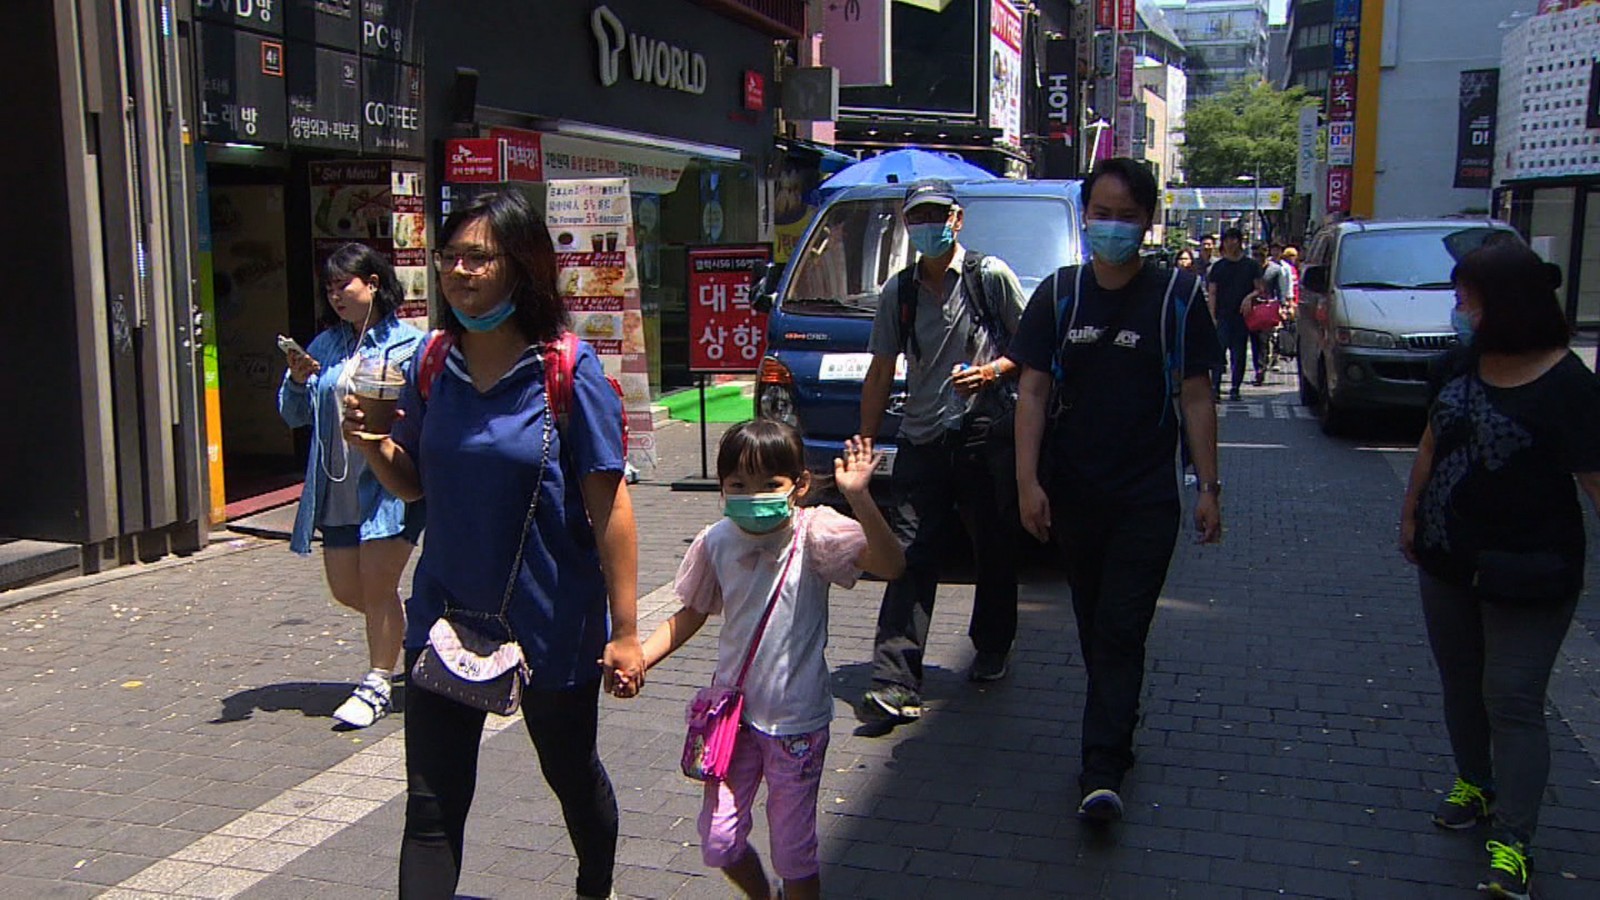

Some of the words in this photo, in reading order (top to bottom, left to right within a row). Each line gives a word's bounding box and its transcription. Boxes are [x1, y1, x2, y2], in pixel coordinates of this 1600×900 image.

[629, 33, 707, 95] WORLD
[364, 101, 418, 130] COFFEE
[1048, 74, 1069, 124] HOT
[200, 100, 258, 136] 노래방
[451, 153, 464, 164] SK
[698, 323, 763, 360] 상향
